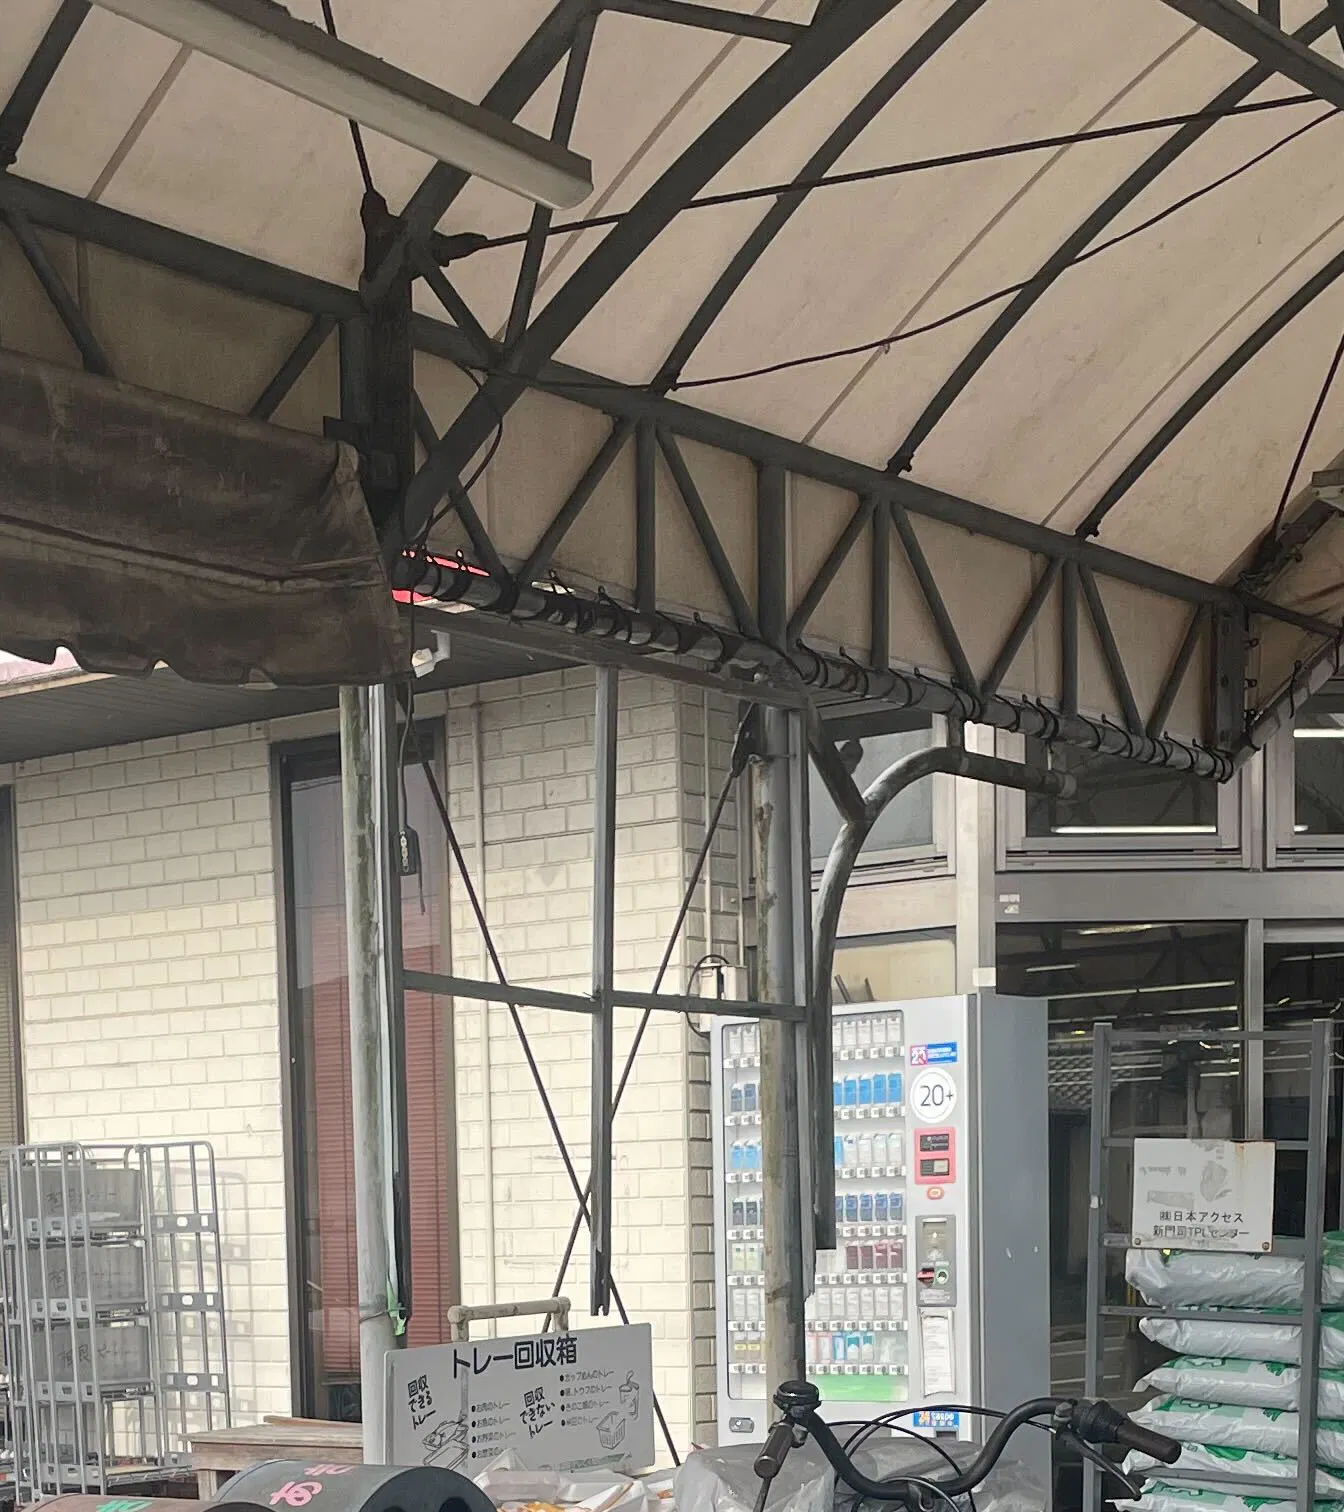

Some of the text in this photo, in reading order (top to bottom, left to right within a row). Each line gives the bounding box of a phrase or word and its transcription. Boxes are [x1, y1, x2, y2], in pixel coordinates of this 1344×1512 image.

[453, 1333, 578, 1379] トレー回収箱
[407, 1375, 428, 1397] 回収
[523, 1386, 545, 1408] 回収
[408, 1390, 434, 1412] できる
[411, 1409, 437, 1430] トレー
[519, 1401, 556, 1424] できない
[527, 1419, 554, 1439] トレー
